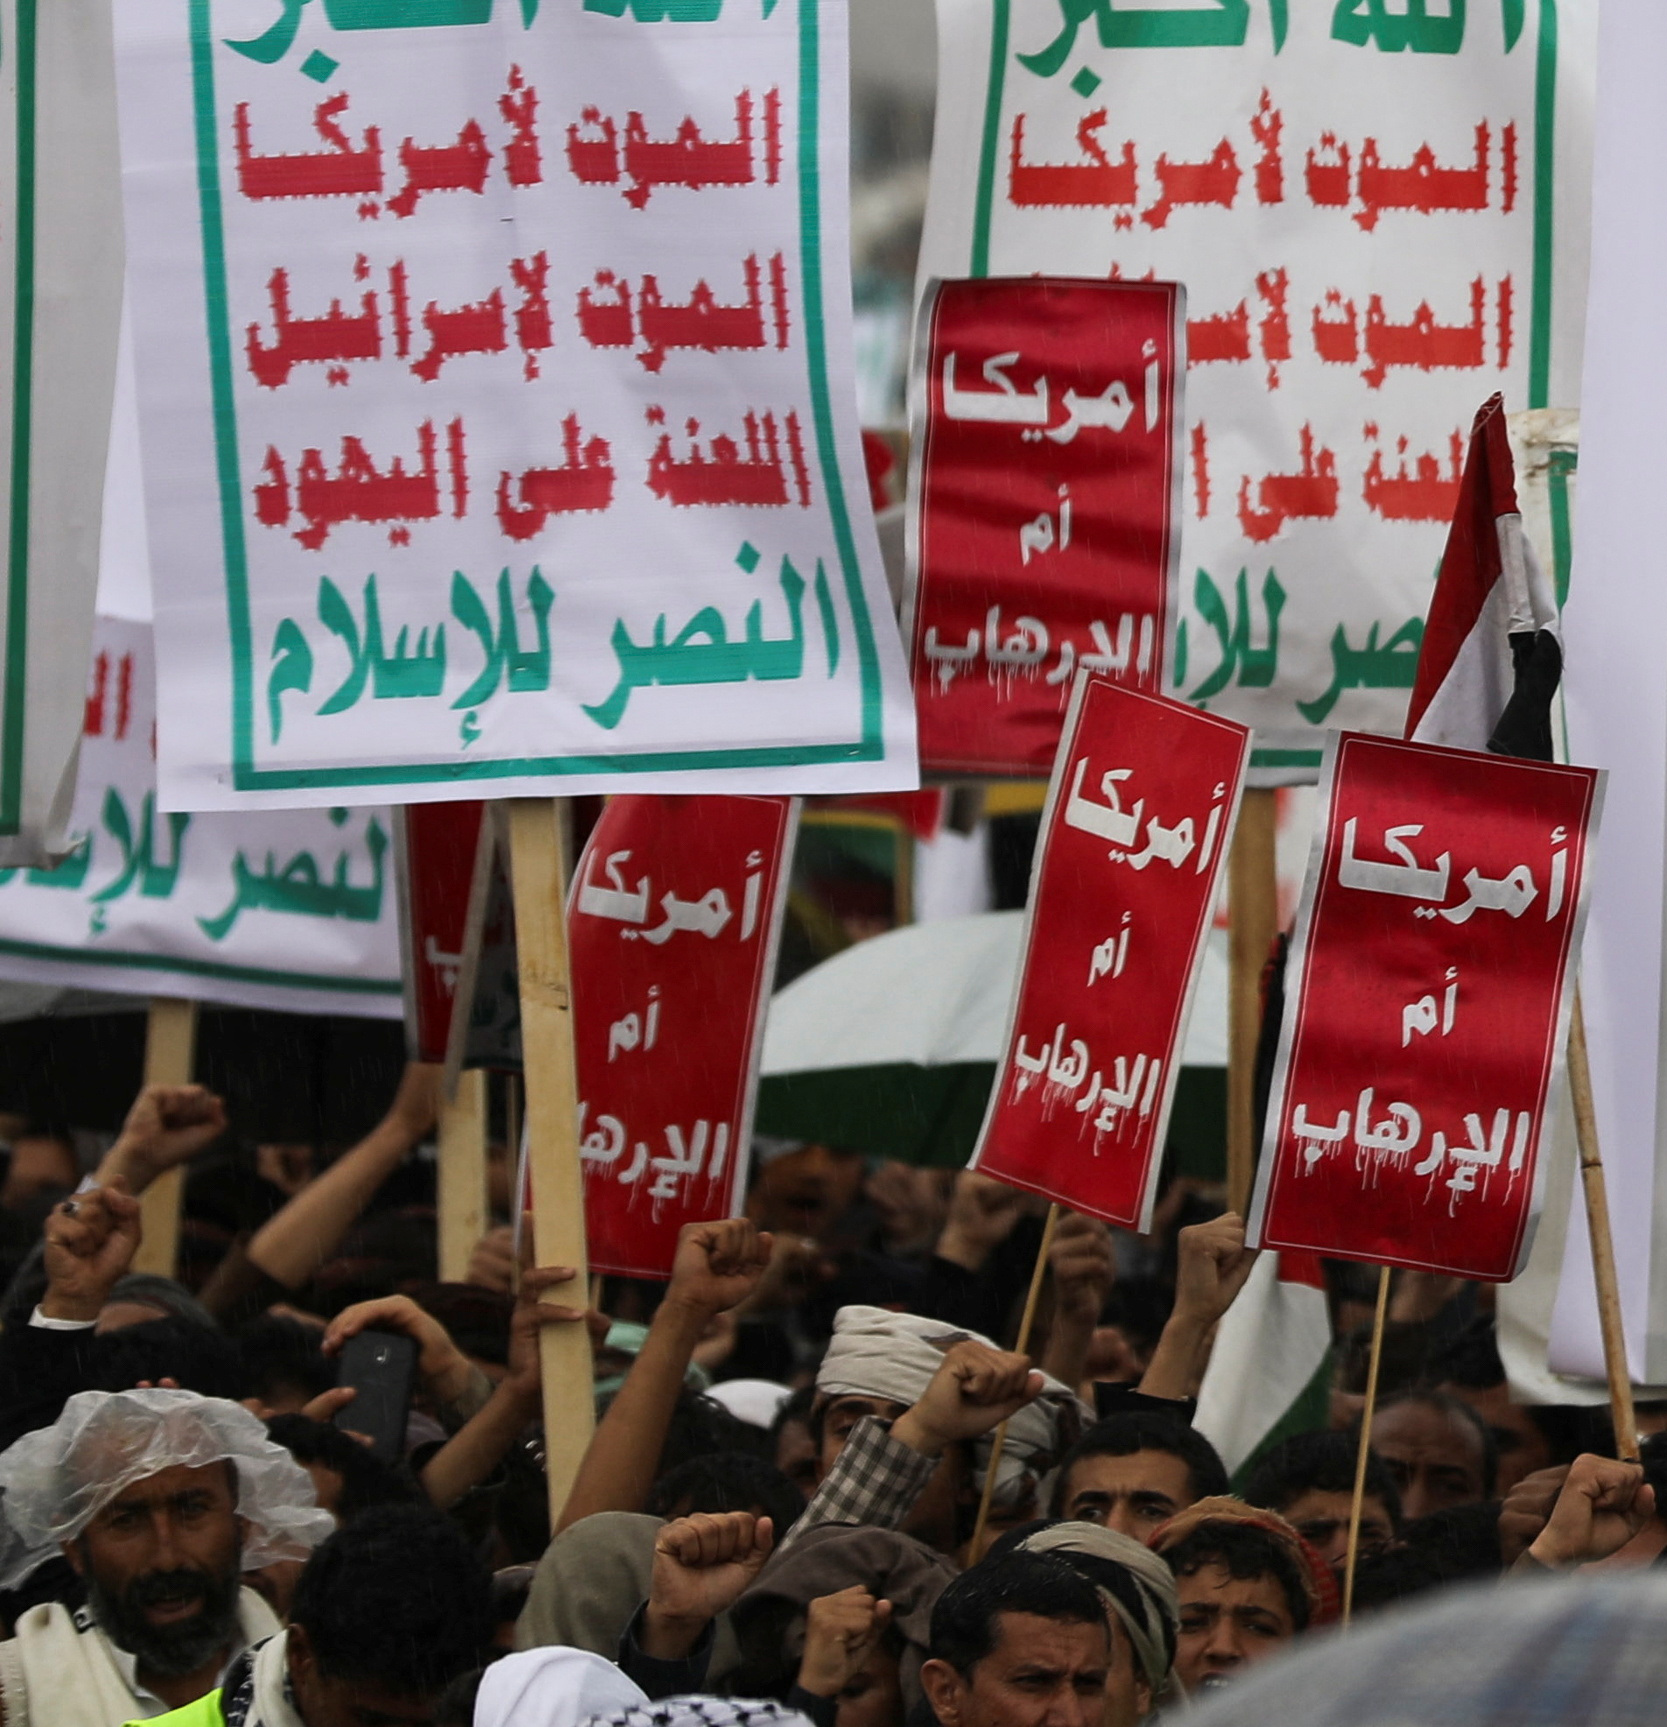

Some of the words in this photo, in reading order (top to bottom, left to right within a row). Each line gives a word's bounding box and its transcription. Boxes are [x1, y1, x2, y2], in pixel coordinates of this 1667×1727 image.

[233, 64, 544, 220] لأمريكا
[564, 88, 783, 210] الموت
[1006, 89, 1286, 231] لأمريكا
[1303, 120, 1519, 233] الموت
[244, 250, 555, 391] لإسرائيل
[575, 252, 792, 374] الموت
[1310, 275, 1515, 390] الموت
[941, 337, 1162, 446] أمريكا
[252, 417, 471, 551] اليهود
[494, 413, 618, 542] على
[645, 405, 812, 509] اللعنة
[1236, 424, 1341, 544] على
[1361, 419, 1467, 525] لعنة
[1018, 482, 1074, 567] أم
[267, 566, 556, 745] للإسلام
[581, 540, 841, 731] النصر
[196, 805, 388, 941] لنصر
[1063, 755, 1227, 876] أمريكا
[1336, 815, 1573, 929] أمريكا
[576, 848, 765, 947] أمريكا
[1085, 909, 1133, 988] أم
[607, 983, 662, 1064] أم
[1401, 964, 1460, 1049] أم
[1012, 1023, 1161, 1144] الإرهاب
[1291, 1087, 1530, 1197] الإرهاب
[577, 1104, 730, 1202] الإره
